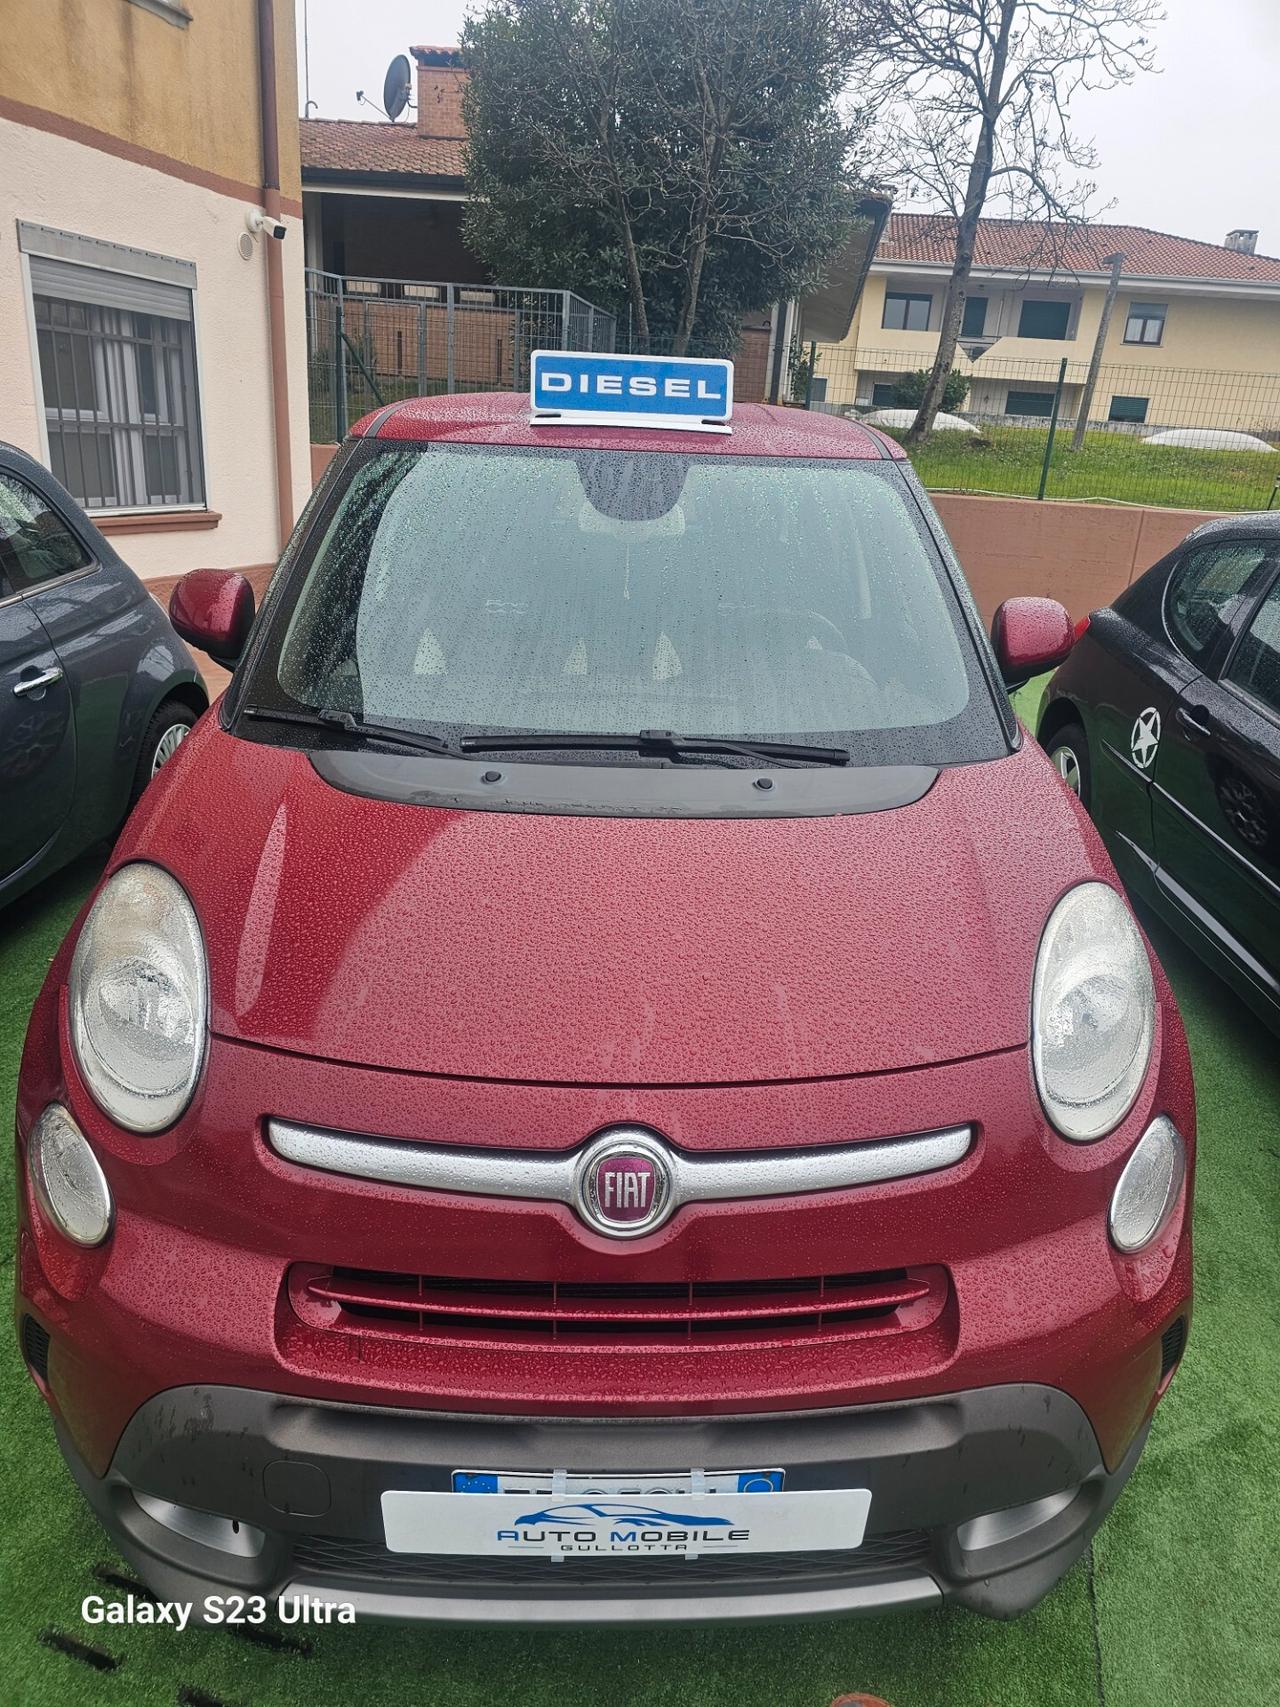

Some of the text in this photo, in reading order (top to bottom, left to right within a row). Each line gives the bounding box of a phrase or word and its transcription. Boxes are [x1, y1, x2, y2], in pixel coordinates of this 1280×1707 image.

[541, 372, 721, 400] DIESEL
[604, 1172, 651, 1208] FIAT
[497, 1529, 750, 1543] AUTO MOBILE
